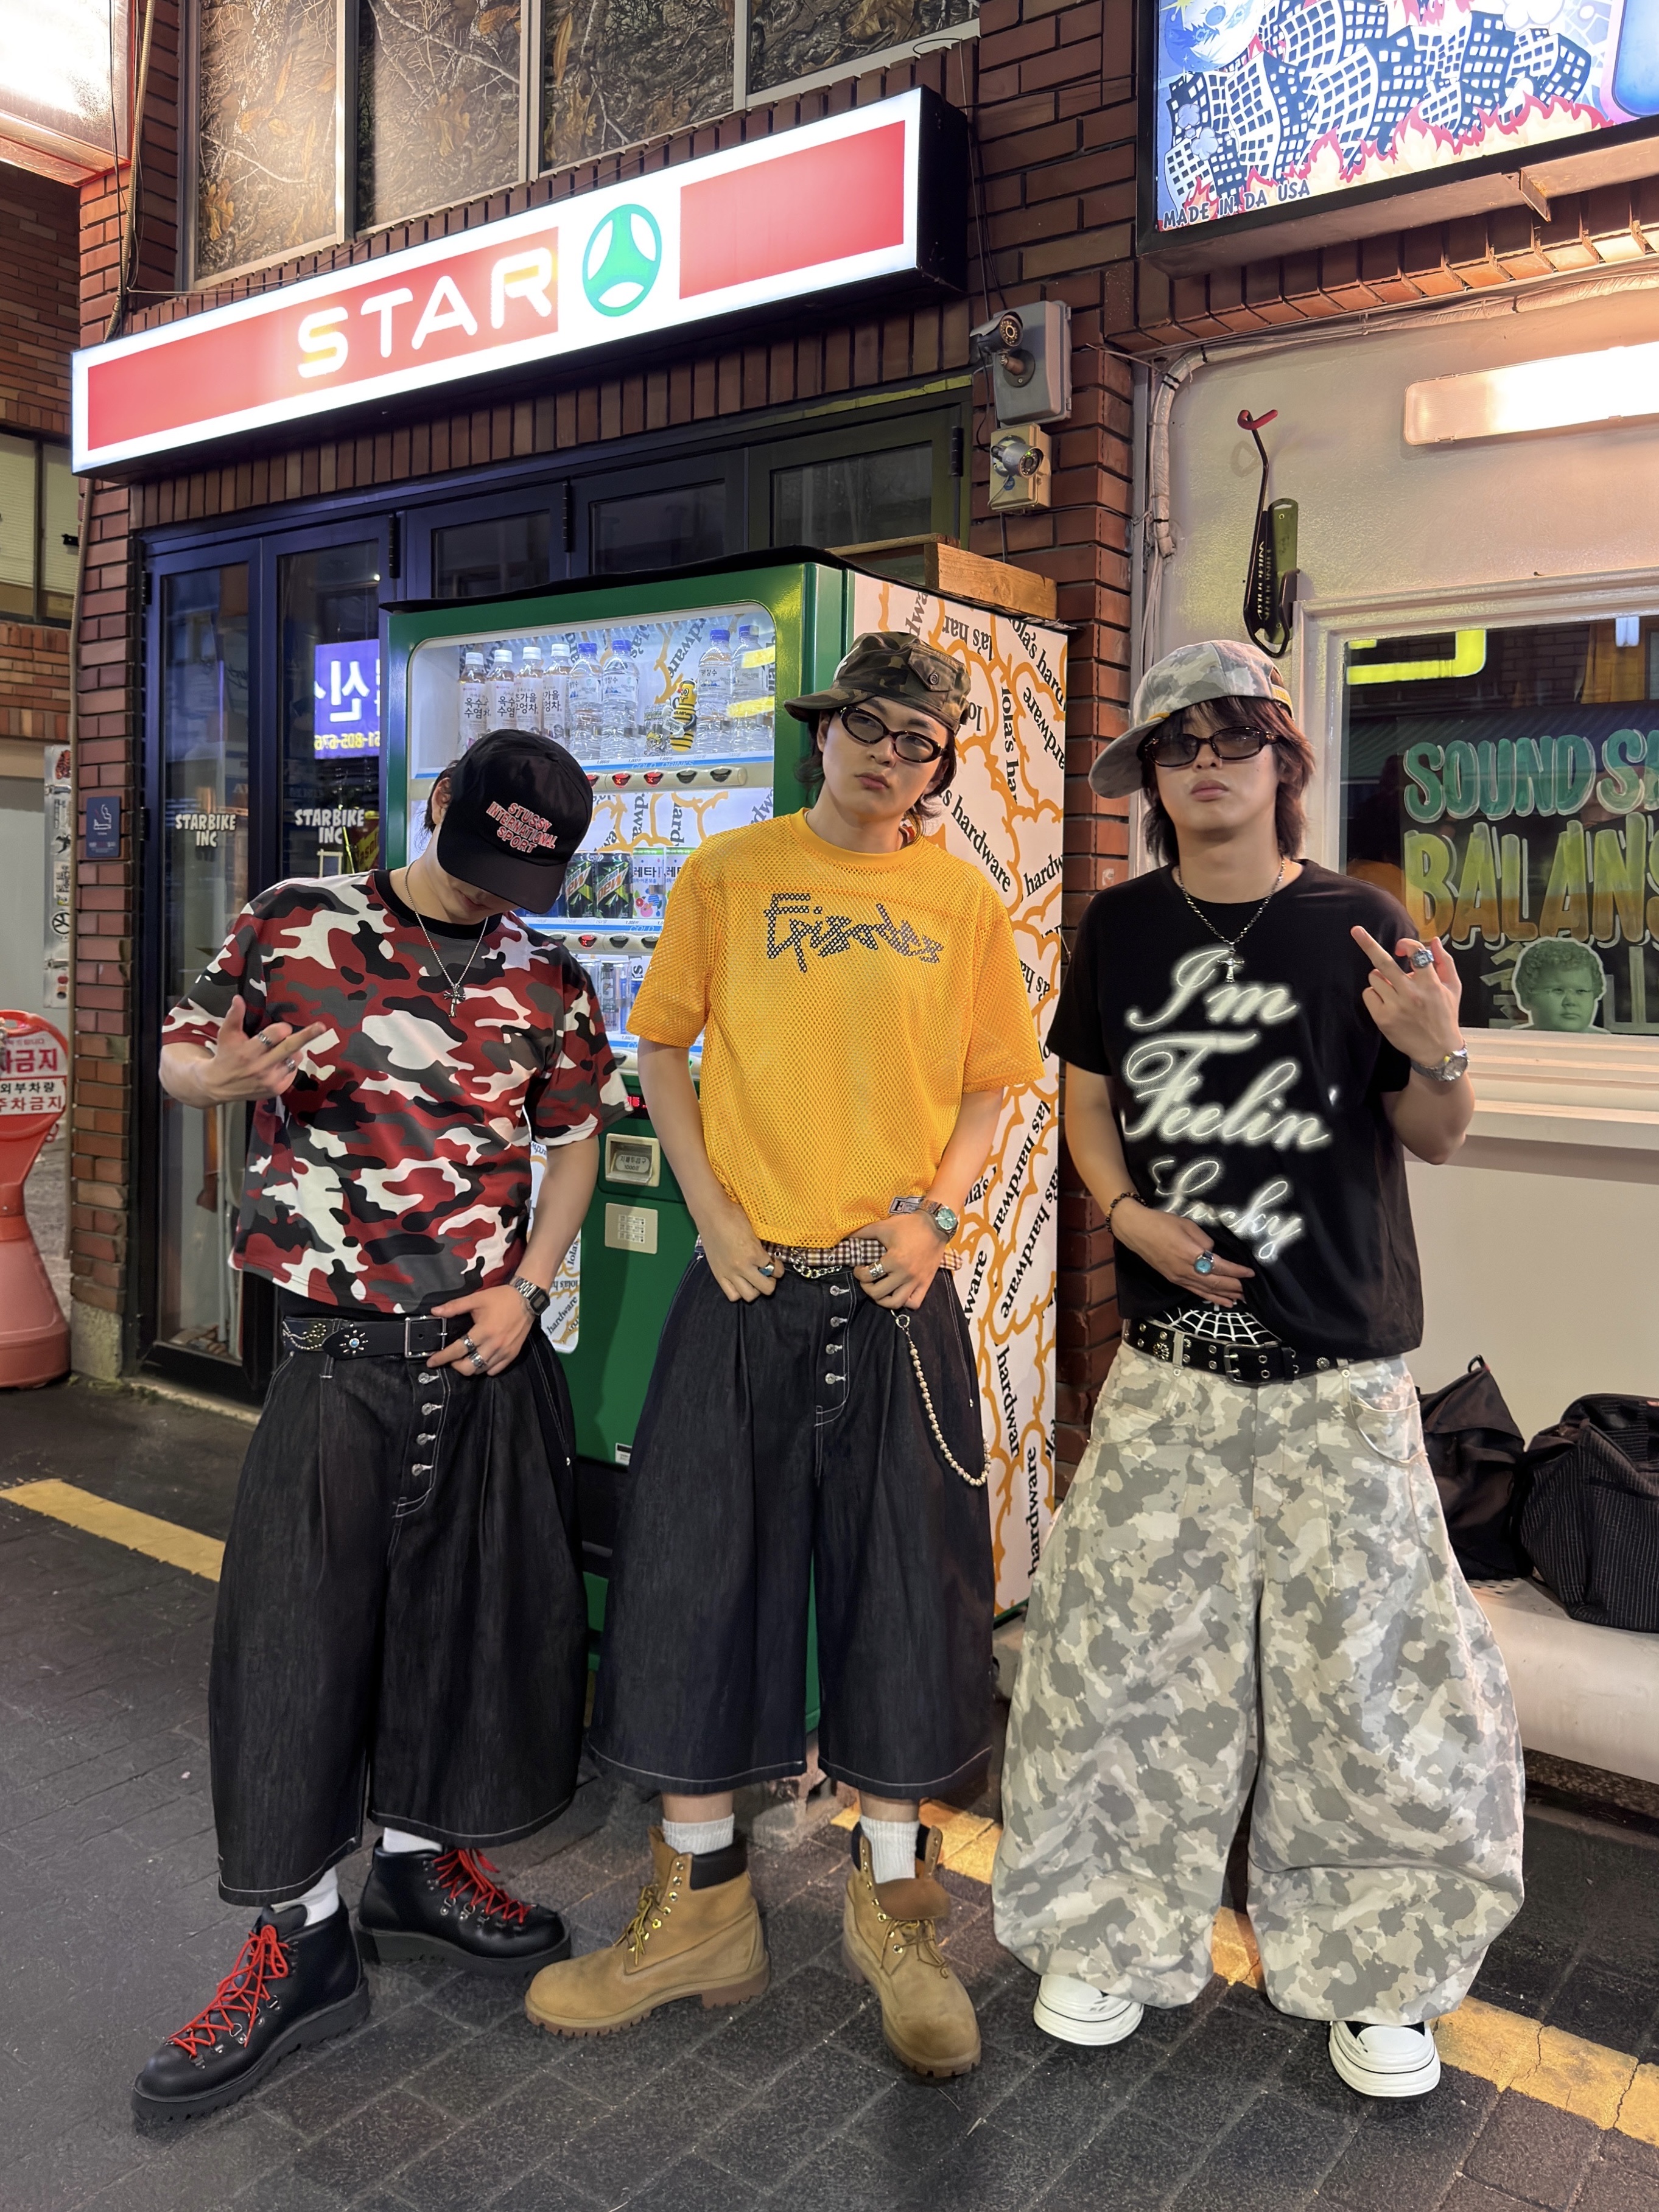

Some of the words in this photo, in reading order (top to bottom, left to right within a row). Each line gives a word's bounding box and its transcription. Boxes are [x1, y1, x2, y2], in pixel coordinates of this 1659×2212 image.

[1163, 202, 1210, 229] MADE
[1218, 196, 1235, 215] IN
[1244, 189, 1268, 209] DA
[1278, 180, 1310, 201] USA
[298, 247, 553, 378] STAR
[1404, 733, 1596, 823] SOUND
[175, 814, 237, 831] STARBIKE
[295, 808, 365, 827] STARBIKE
[318, 826, 343, 844] INC
[486, 801, 558, 849] INTERNATIONAL
[508, 802, 552, 832] STUSSY
[196, 830, 217, 847] INC
[497, 826, 538, 853] SPORT
[951, 794, 1011, 892] hardware
[1001, 1203, 1050, 1318] hardware
[546, 1296, 578, 1334] hardware
